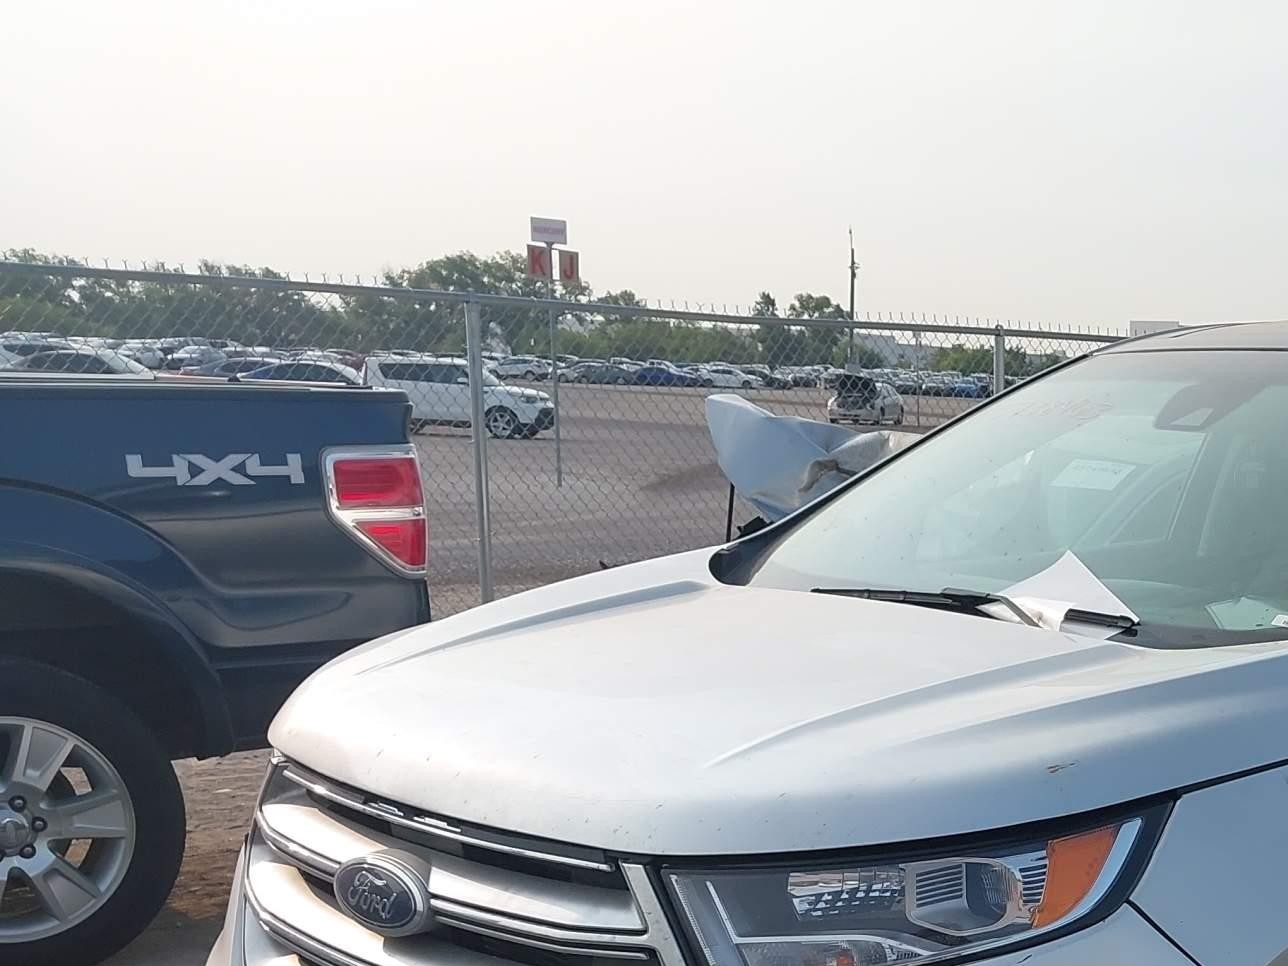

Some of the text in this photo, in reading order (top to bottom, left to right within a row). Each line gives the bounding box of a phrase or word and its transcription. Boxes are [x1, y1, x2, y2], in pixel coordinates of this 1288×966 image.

[531, 248, 546, 276] K
[563, 254, 575, 280] J
[348, 870, 397, 920] Ford
